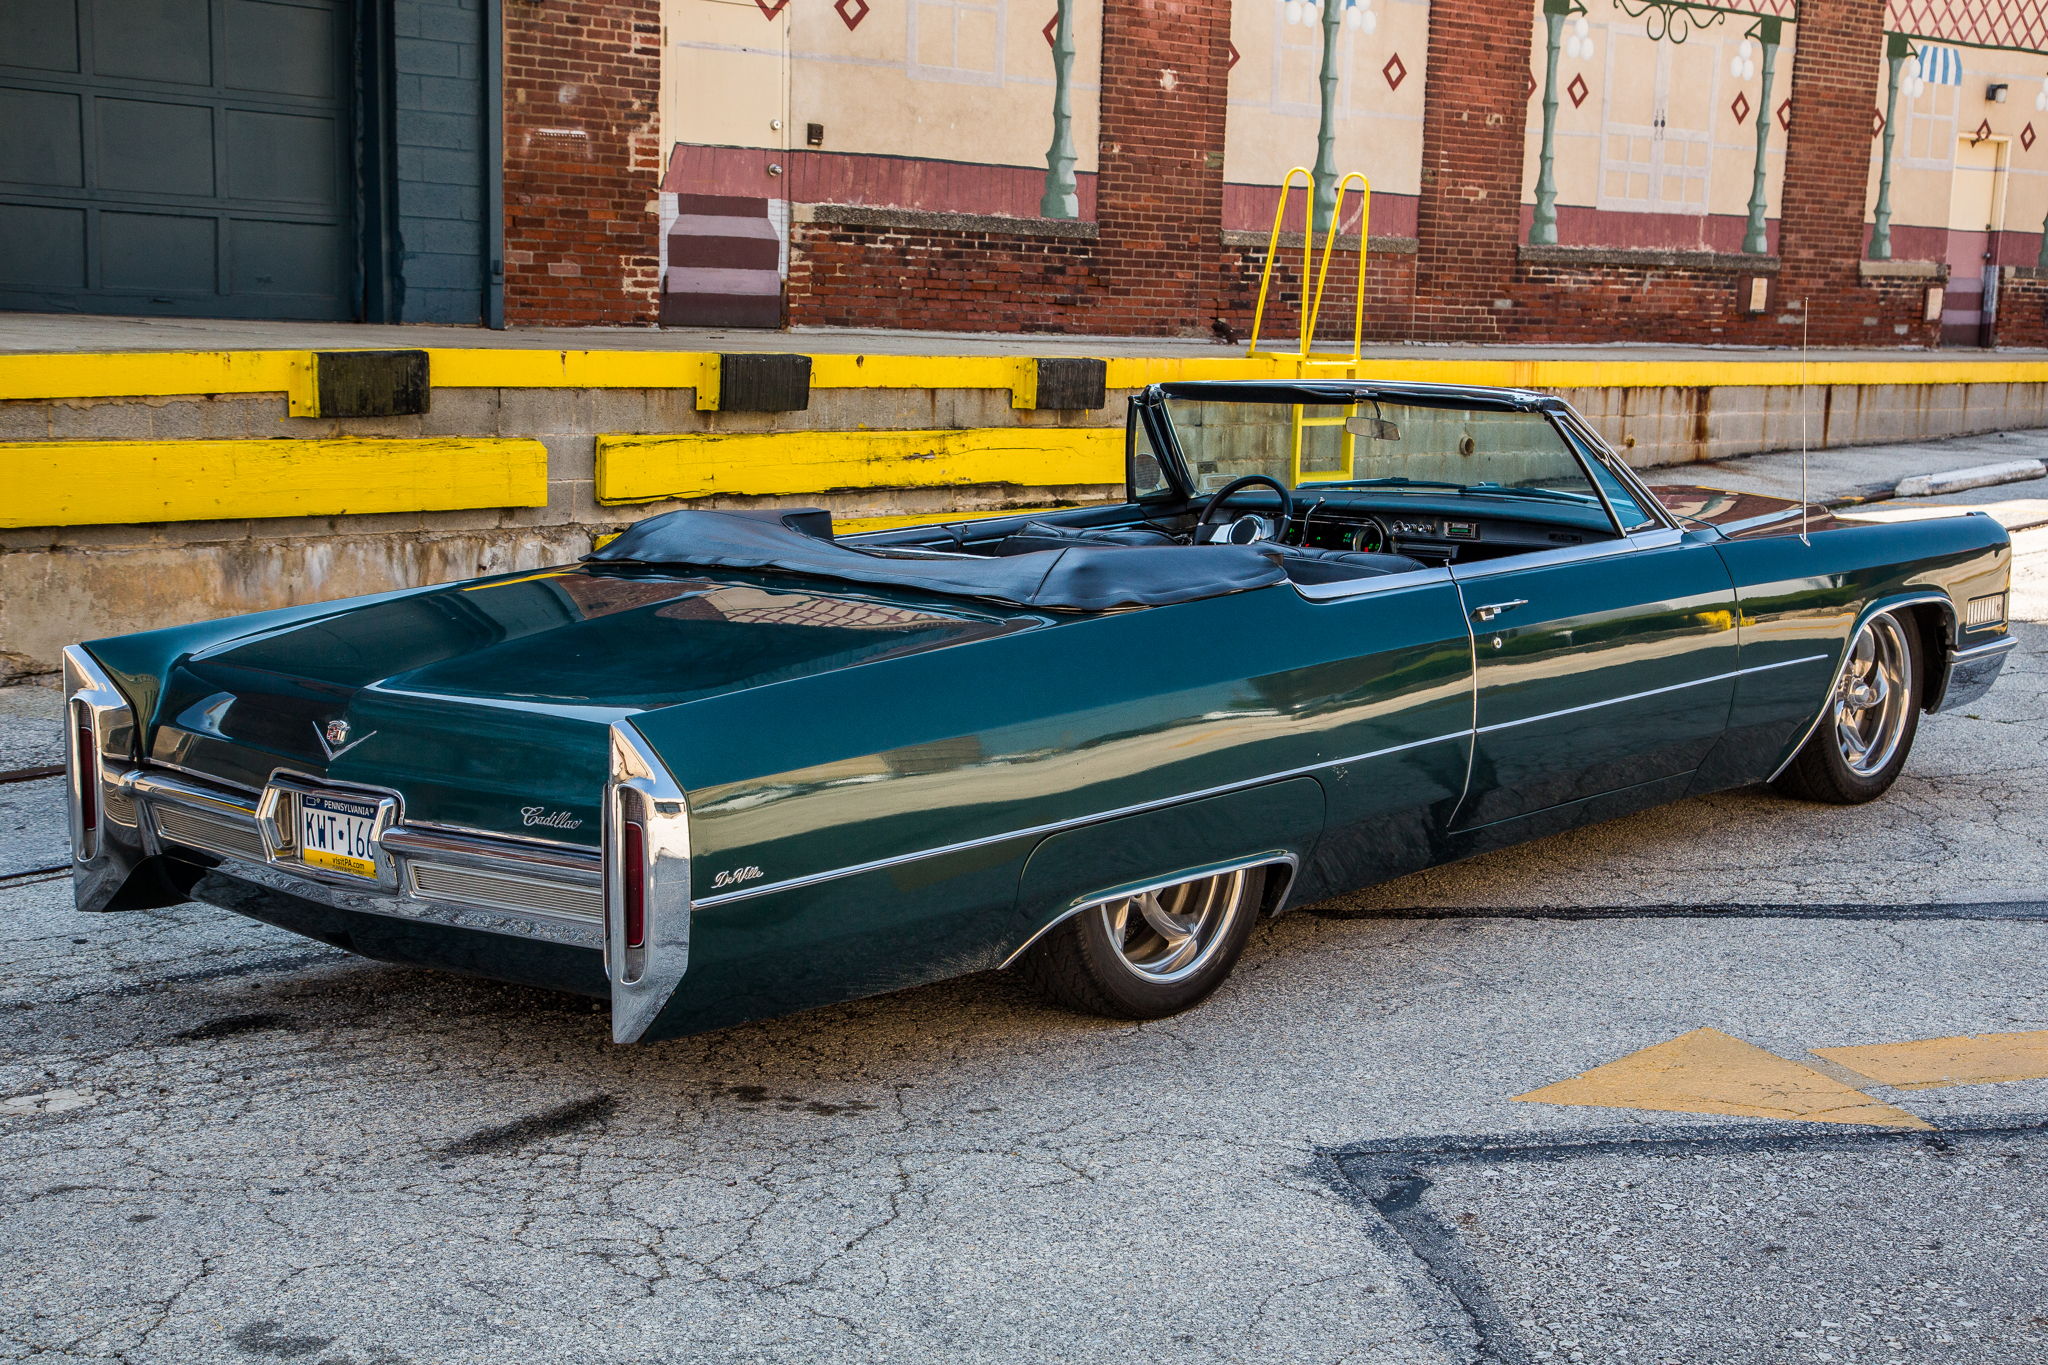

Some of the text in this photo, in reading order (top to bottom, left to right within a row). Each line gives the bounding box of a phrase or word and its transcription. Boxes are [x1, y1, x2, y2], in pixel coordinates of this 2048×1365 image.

[324, 800, 370, 816] PENNSYLVANIA
[520, 806, 583, 830] Cadillac
[332, 857, 365, 870] visitPA.com
